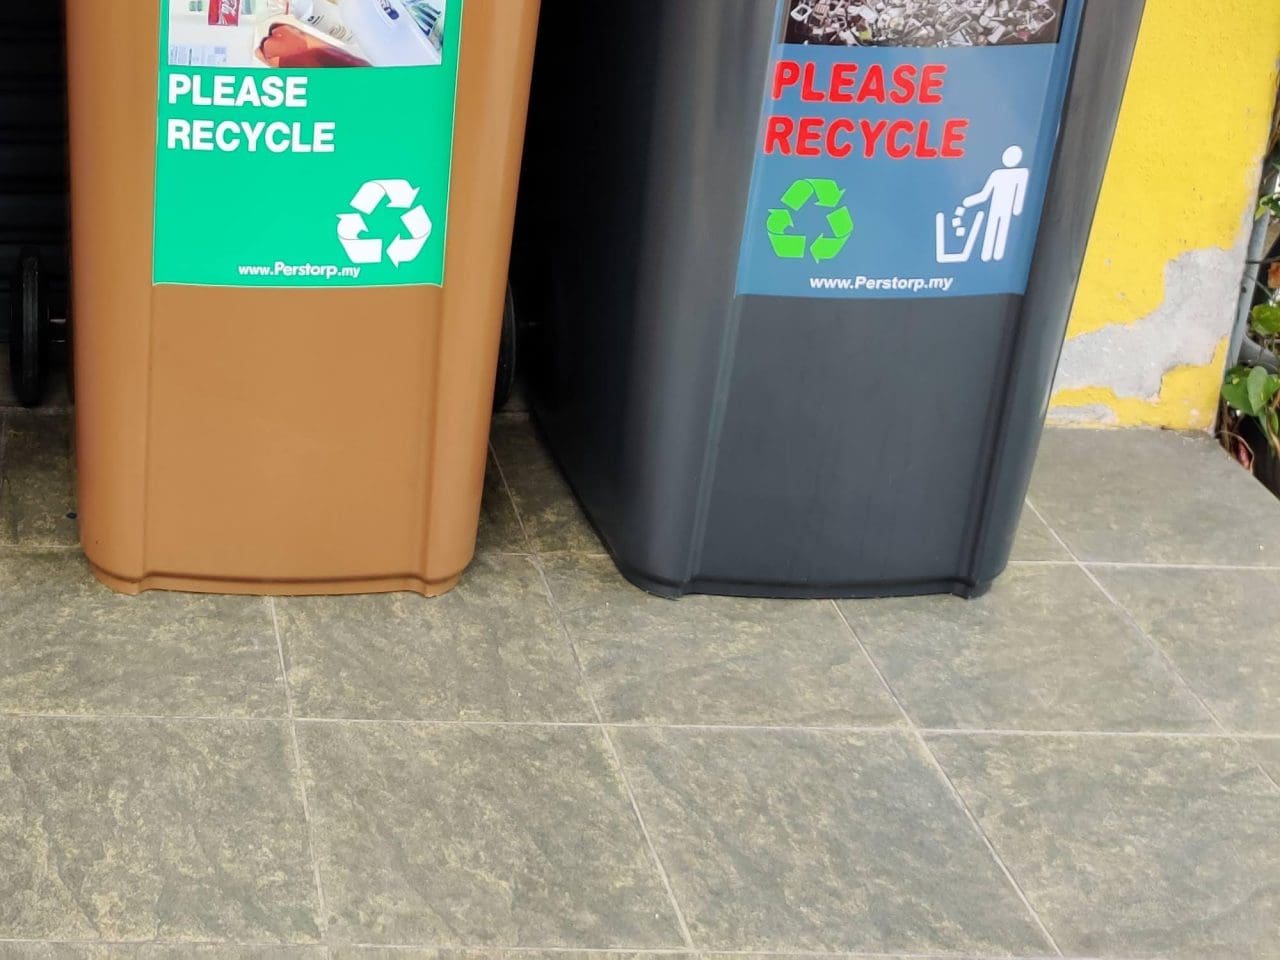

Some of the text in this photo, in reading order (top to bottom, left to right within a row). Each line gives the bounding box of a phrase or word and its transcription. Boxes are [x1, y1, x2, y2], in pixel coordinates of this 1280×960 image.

[168, 74, 308, 108] PLEASE
[770, 61, 947, 105] PLEASE
[166, 118, 335, 152] RECYCLE
[763, 116, 969, 160] RECYCLE
[238, 261, 360, 279] www.Perstorp.my
[809, 275, 953, 292] www.Perstorp.my
